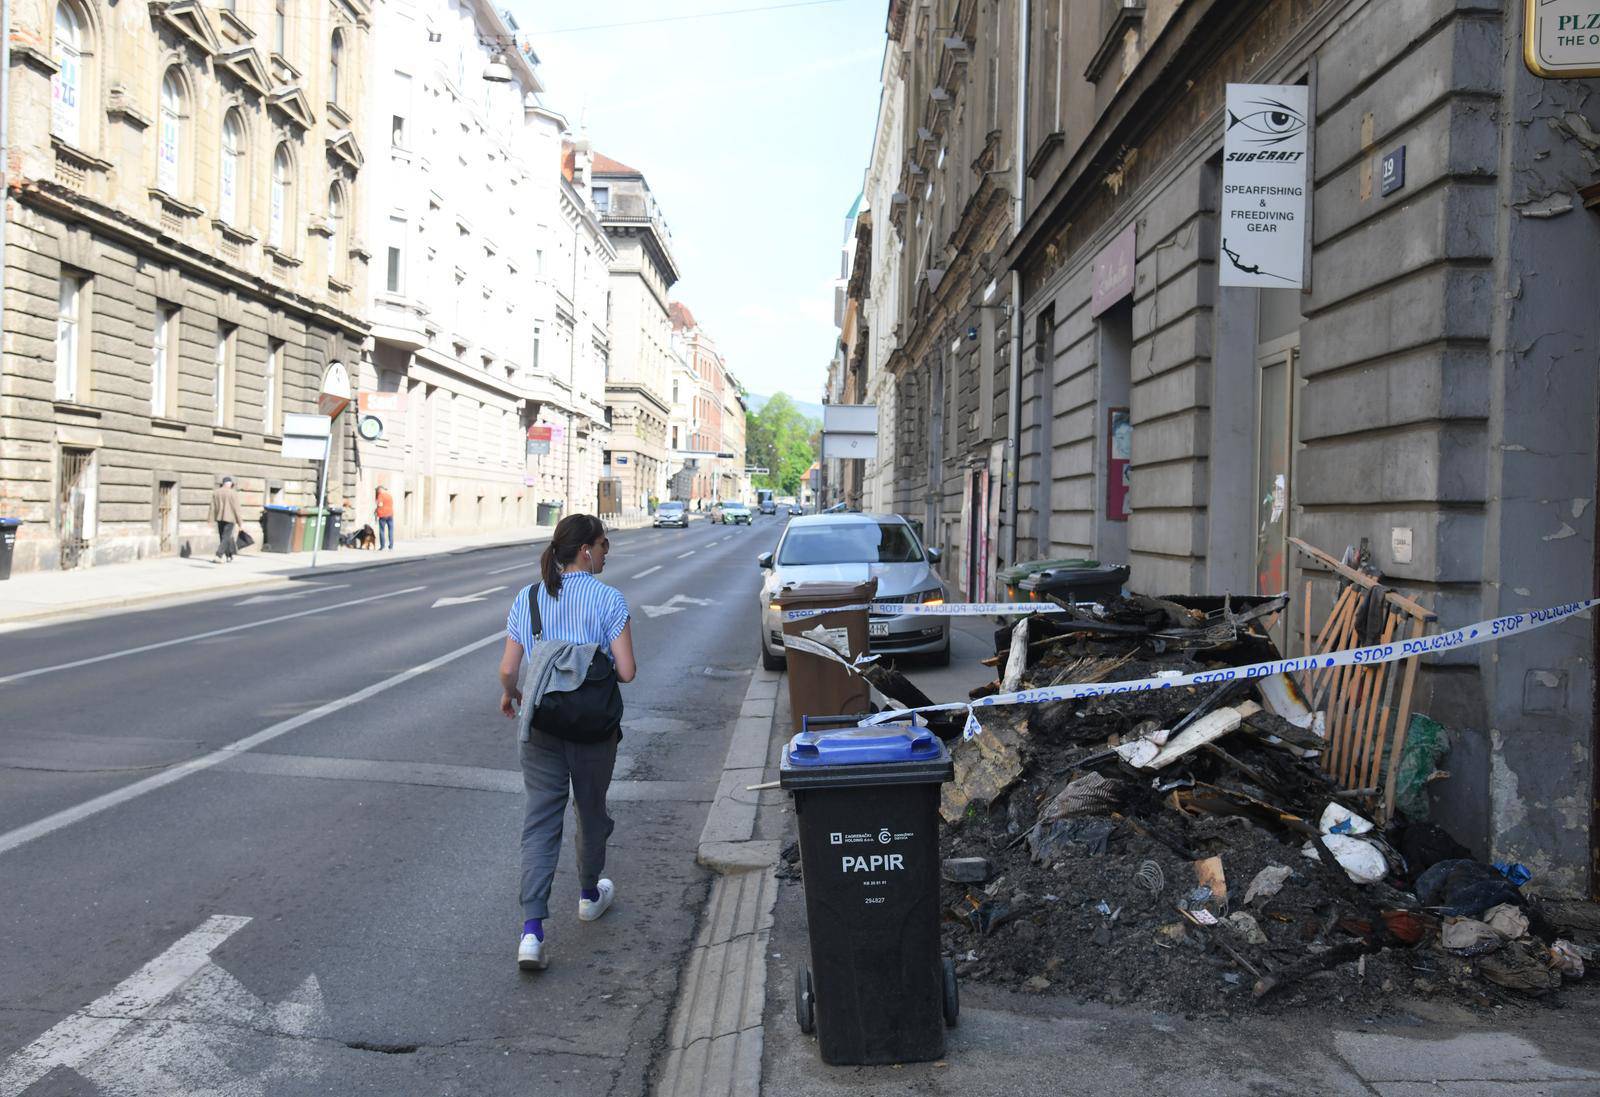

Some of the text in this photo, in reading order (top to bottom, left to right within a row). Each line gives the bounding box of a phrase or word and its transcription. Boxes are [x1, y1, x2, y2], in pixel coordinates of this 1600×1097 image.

[1557, 36, 1585, 46] THE
[1225, 150, 1304, 162] SUBCRAFT
[1383, 157, 1394, 178] 19
[1224, 184, 1303, 196] SPEARFISHING
[1259, 198, 1266, 207] &
[1230, 210, 1294, 221] FREEDIVING
[1246, 223, 1277, 232] GEAR
[1491, 615, 1524, 634] STOP
[1353, 631, 1464, 664] STOP POLICIJA
[1193, 670, 1236, 685] STOP
[842, 854, 905, 872] PAPIR
